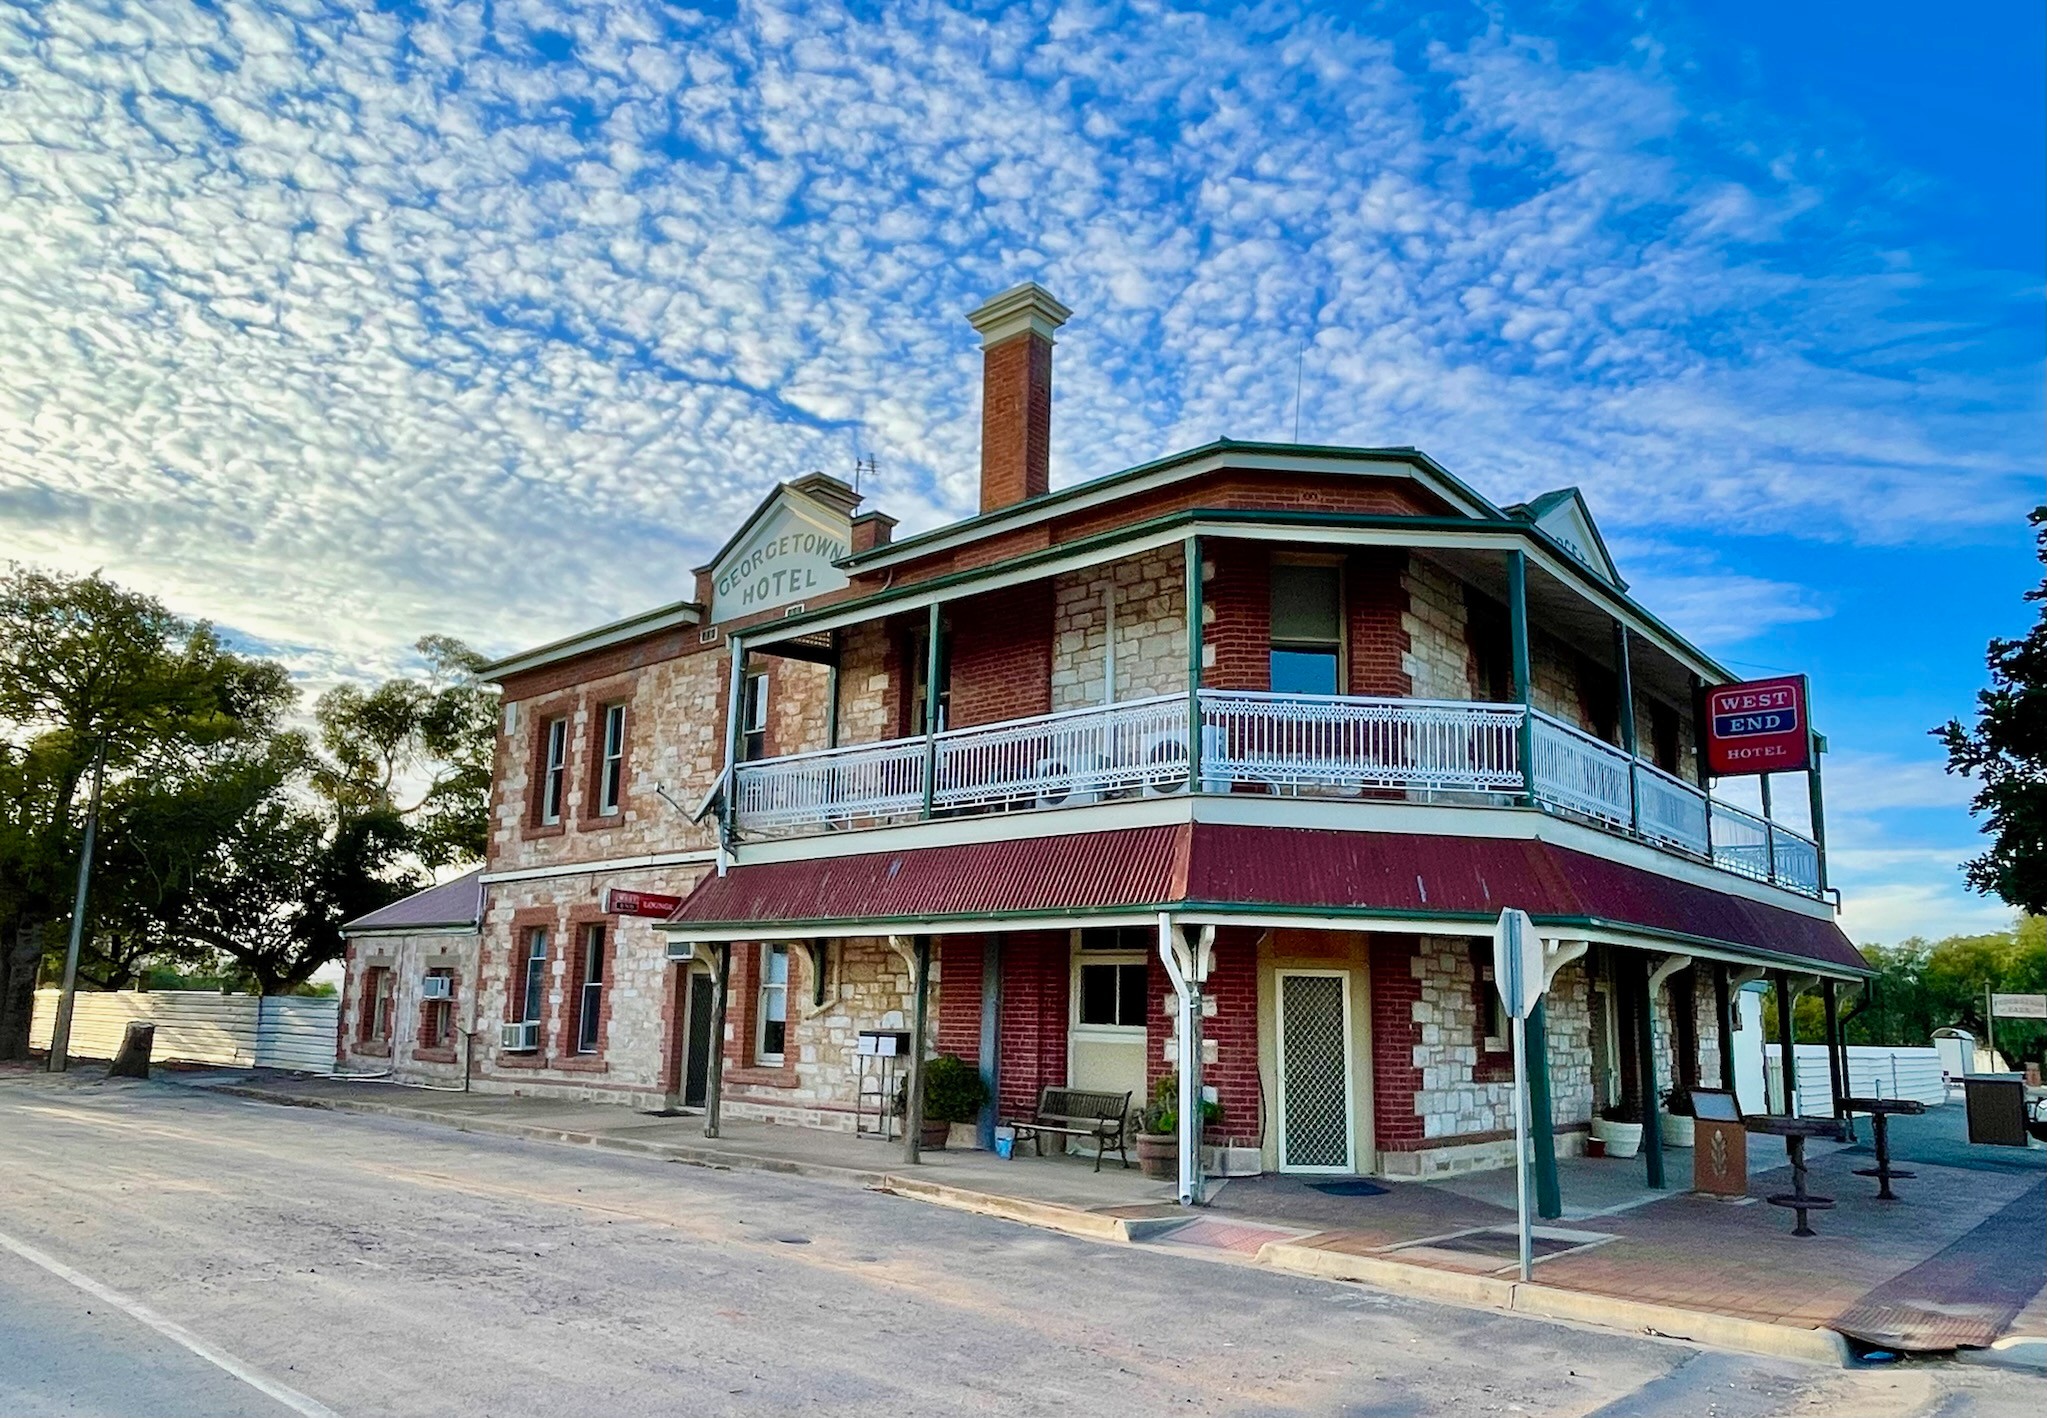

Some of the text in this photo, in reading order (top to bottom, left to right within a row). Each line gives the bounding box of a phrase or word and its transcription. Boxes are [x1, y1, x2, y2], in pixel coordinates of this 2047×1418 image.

[718, 533, 845, 597] GEORGETOWN
[742, 568, 817, 606] HOTEL
[1720, 691, 1788, 711] WEST
[1729, 715, 1781, 732] END
[1727, 745, 1787, 760] HOTEL
